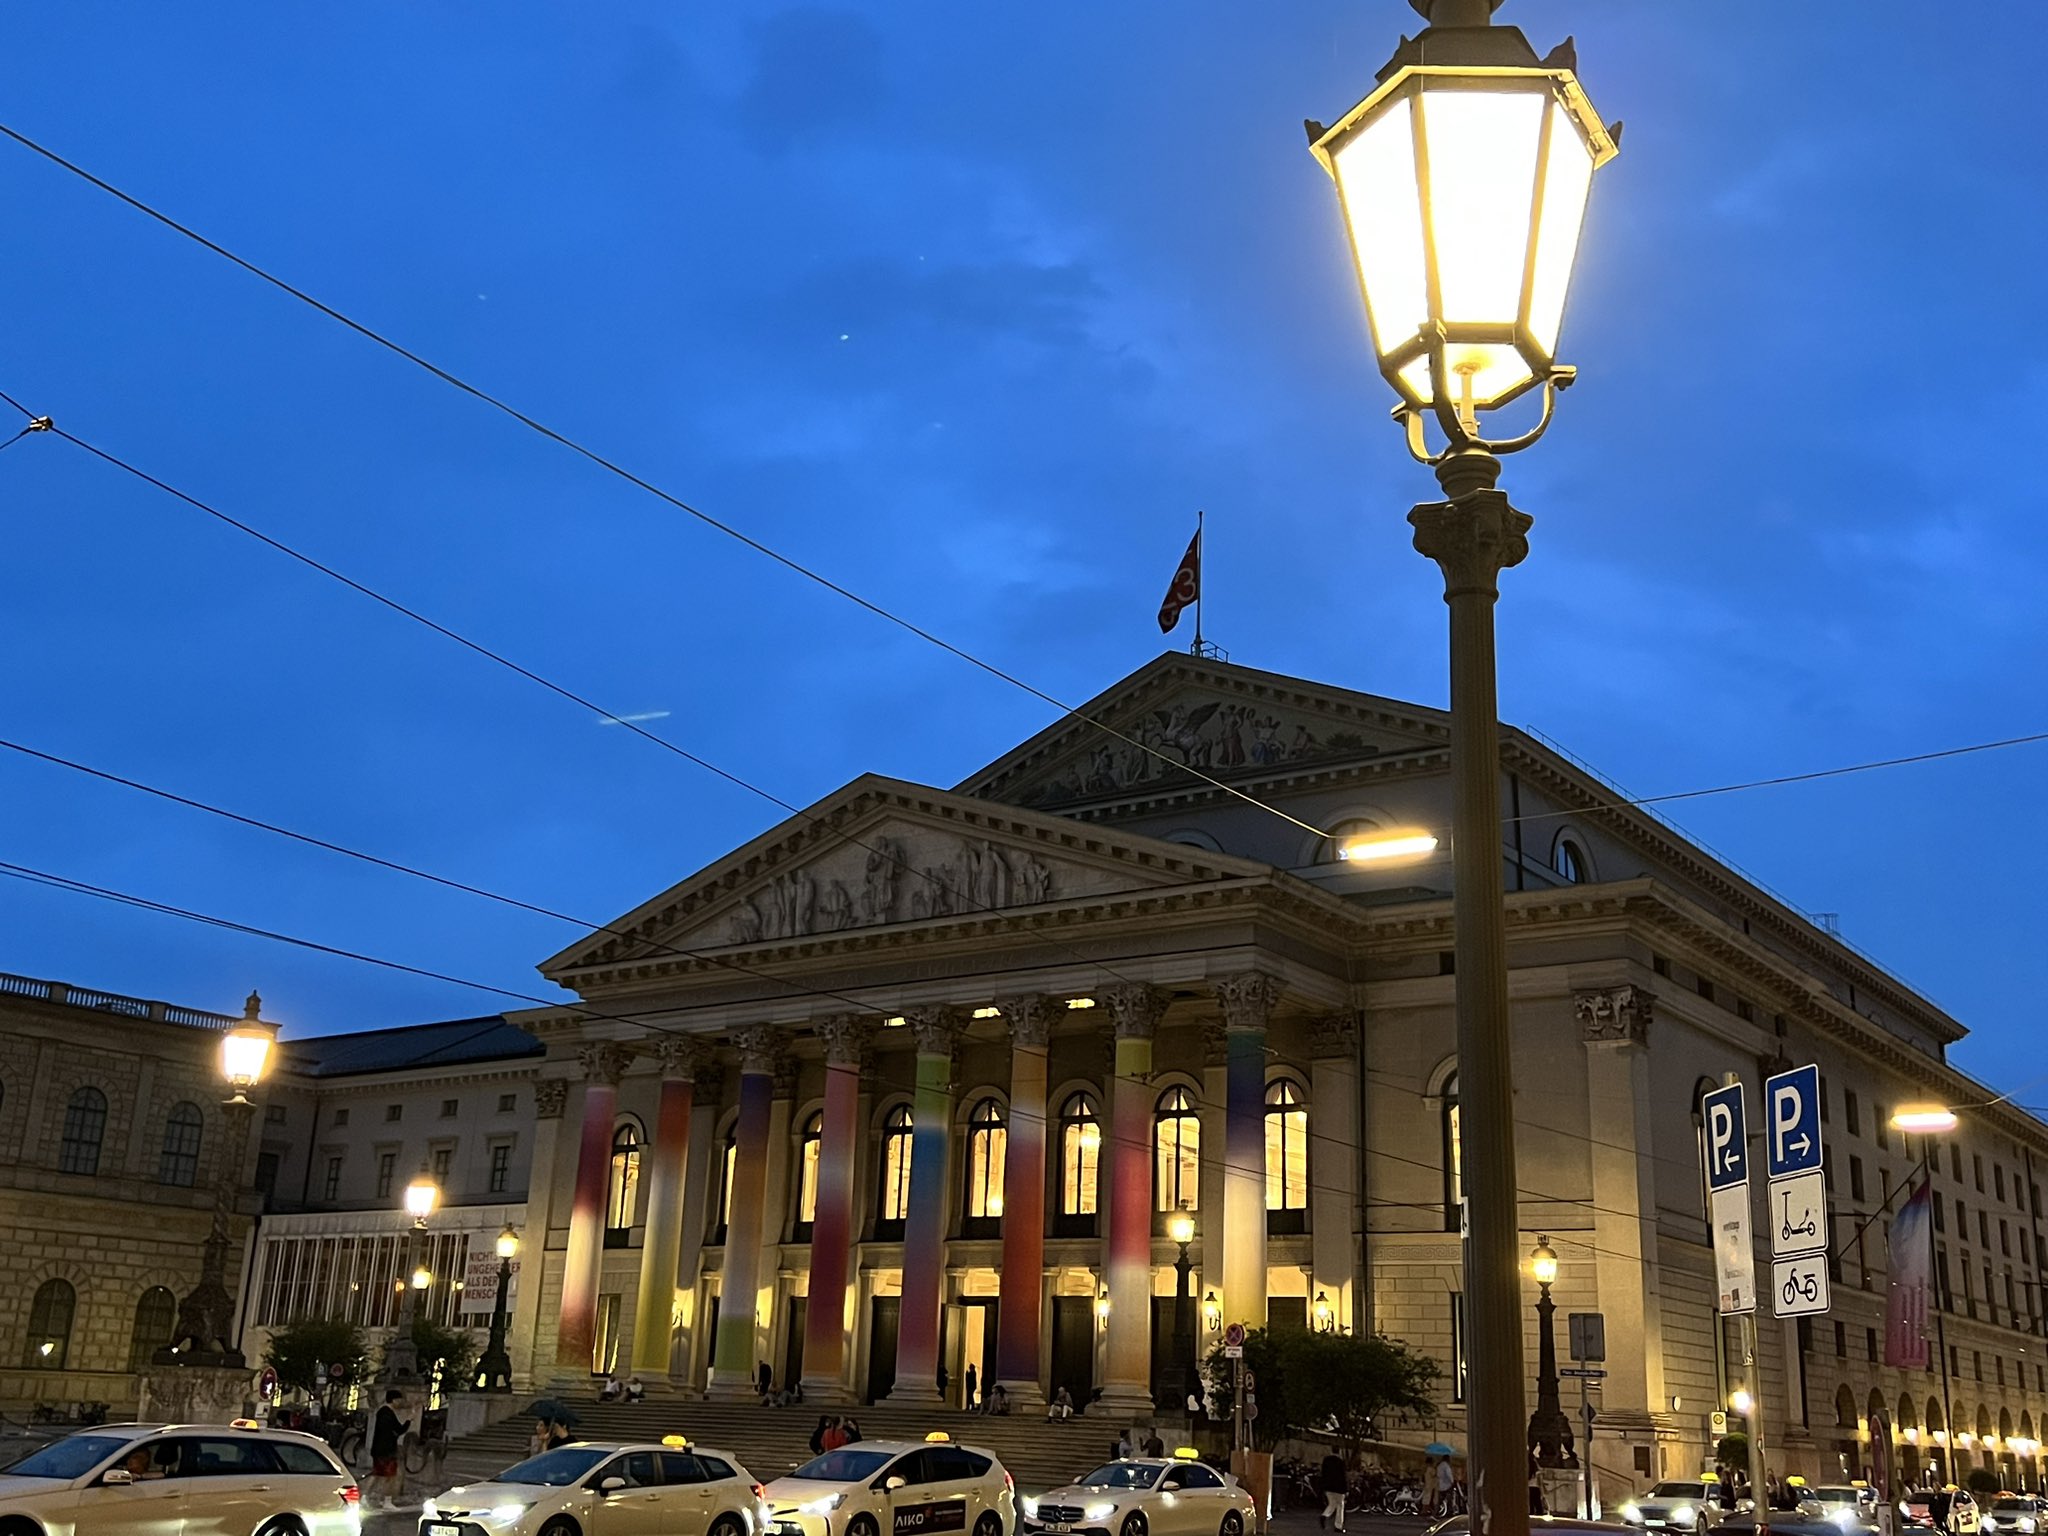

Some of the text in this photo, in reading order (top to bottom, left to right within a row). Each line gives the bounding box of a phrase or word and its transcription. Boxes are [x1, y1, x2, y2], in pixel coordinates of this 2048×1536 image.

[1710, 1103, 1732, 1175] P
[1774, 1085, 1802, 1162] P
[466, 1276, 480, 1287] ALS
[895, 1513, 924, 1528] AIKO
